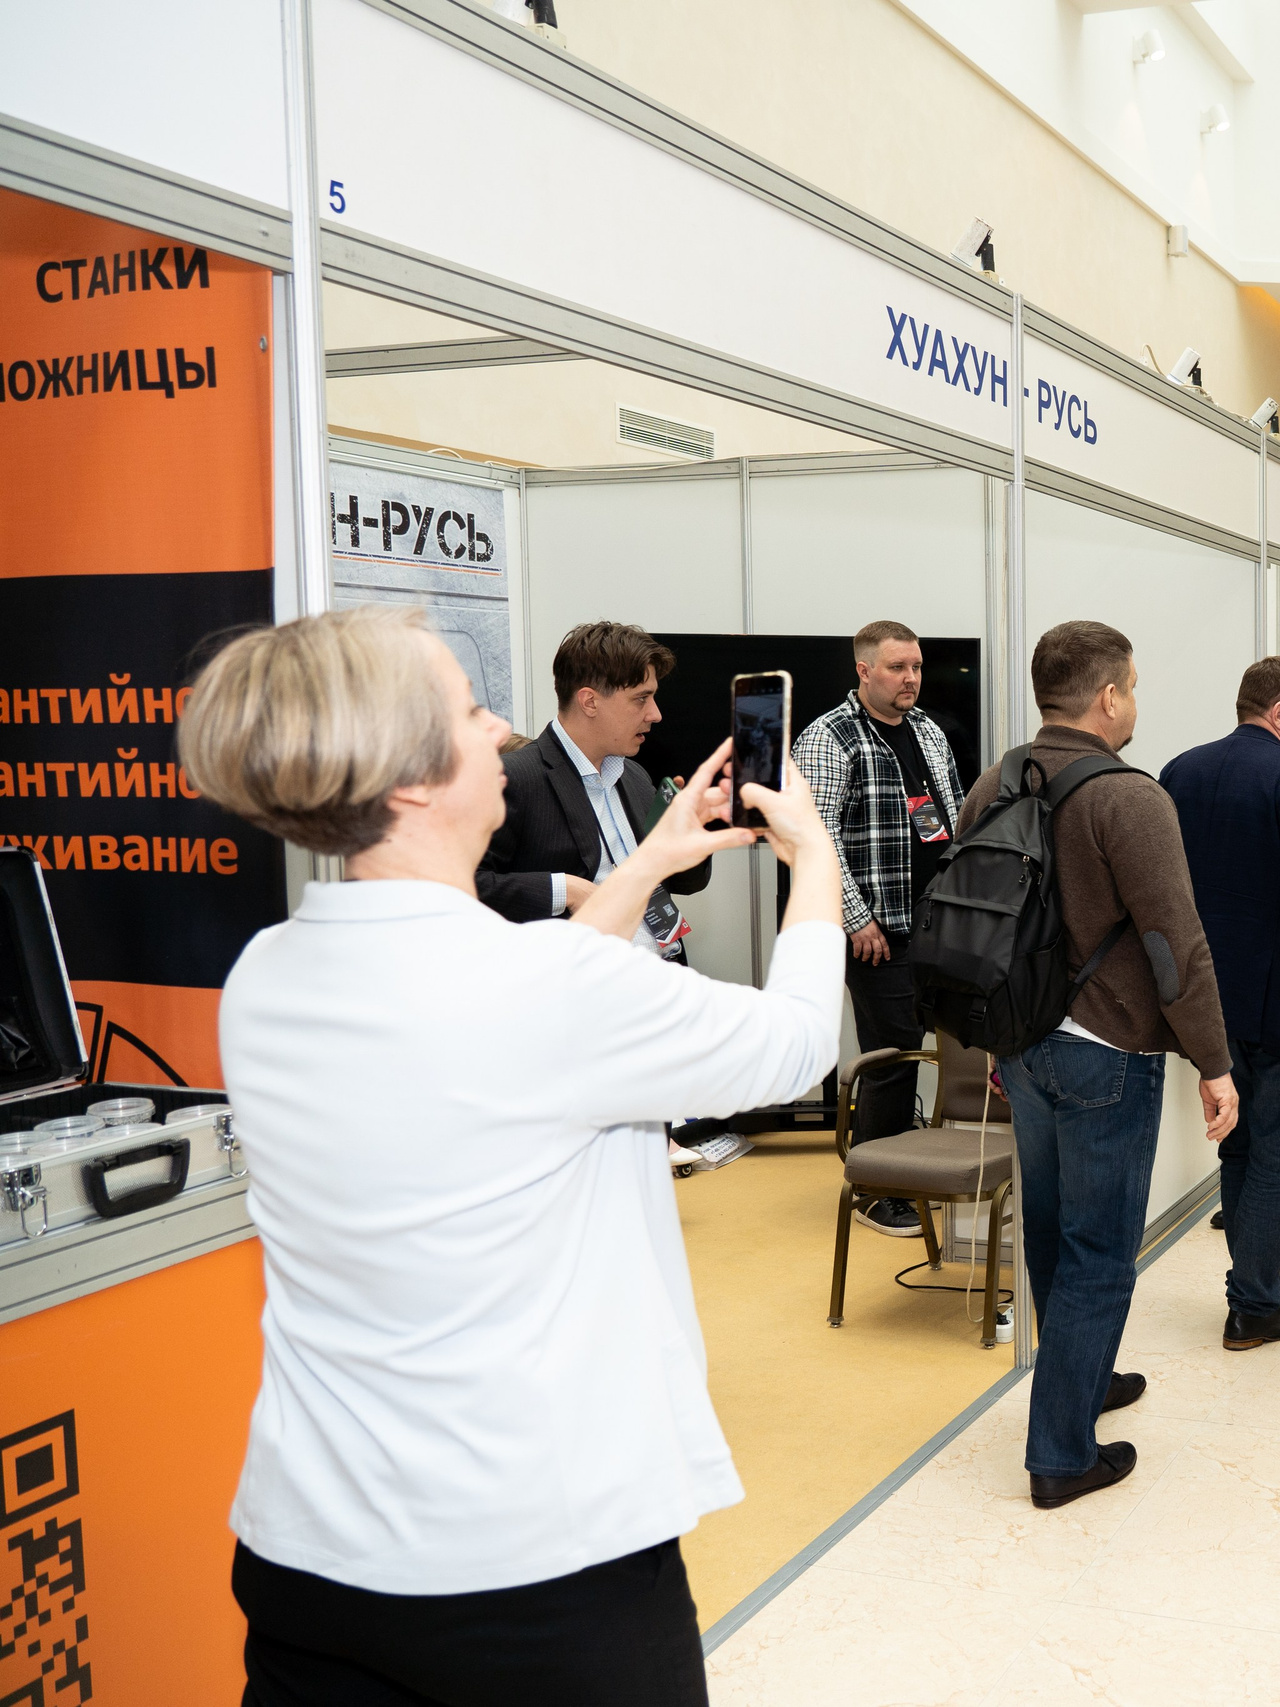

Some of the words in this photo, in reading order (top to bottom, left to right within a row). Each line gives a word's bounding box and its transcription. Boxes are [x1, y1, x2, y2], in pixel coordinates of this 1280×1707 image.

[328, 179, 346, 215] 5
[36, 246, 210, 304] СТАНКИ
[0, 346, 218, 402] ОЖНИЦЫ
[885, 304, 1008, 408] ХУАХУН
[1037, 377, 1098, 445] РУСЬ
[330, 491, 495, 563] Н-РУСЬ
[0, 834, 240, 875] живание
